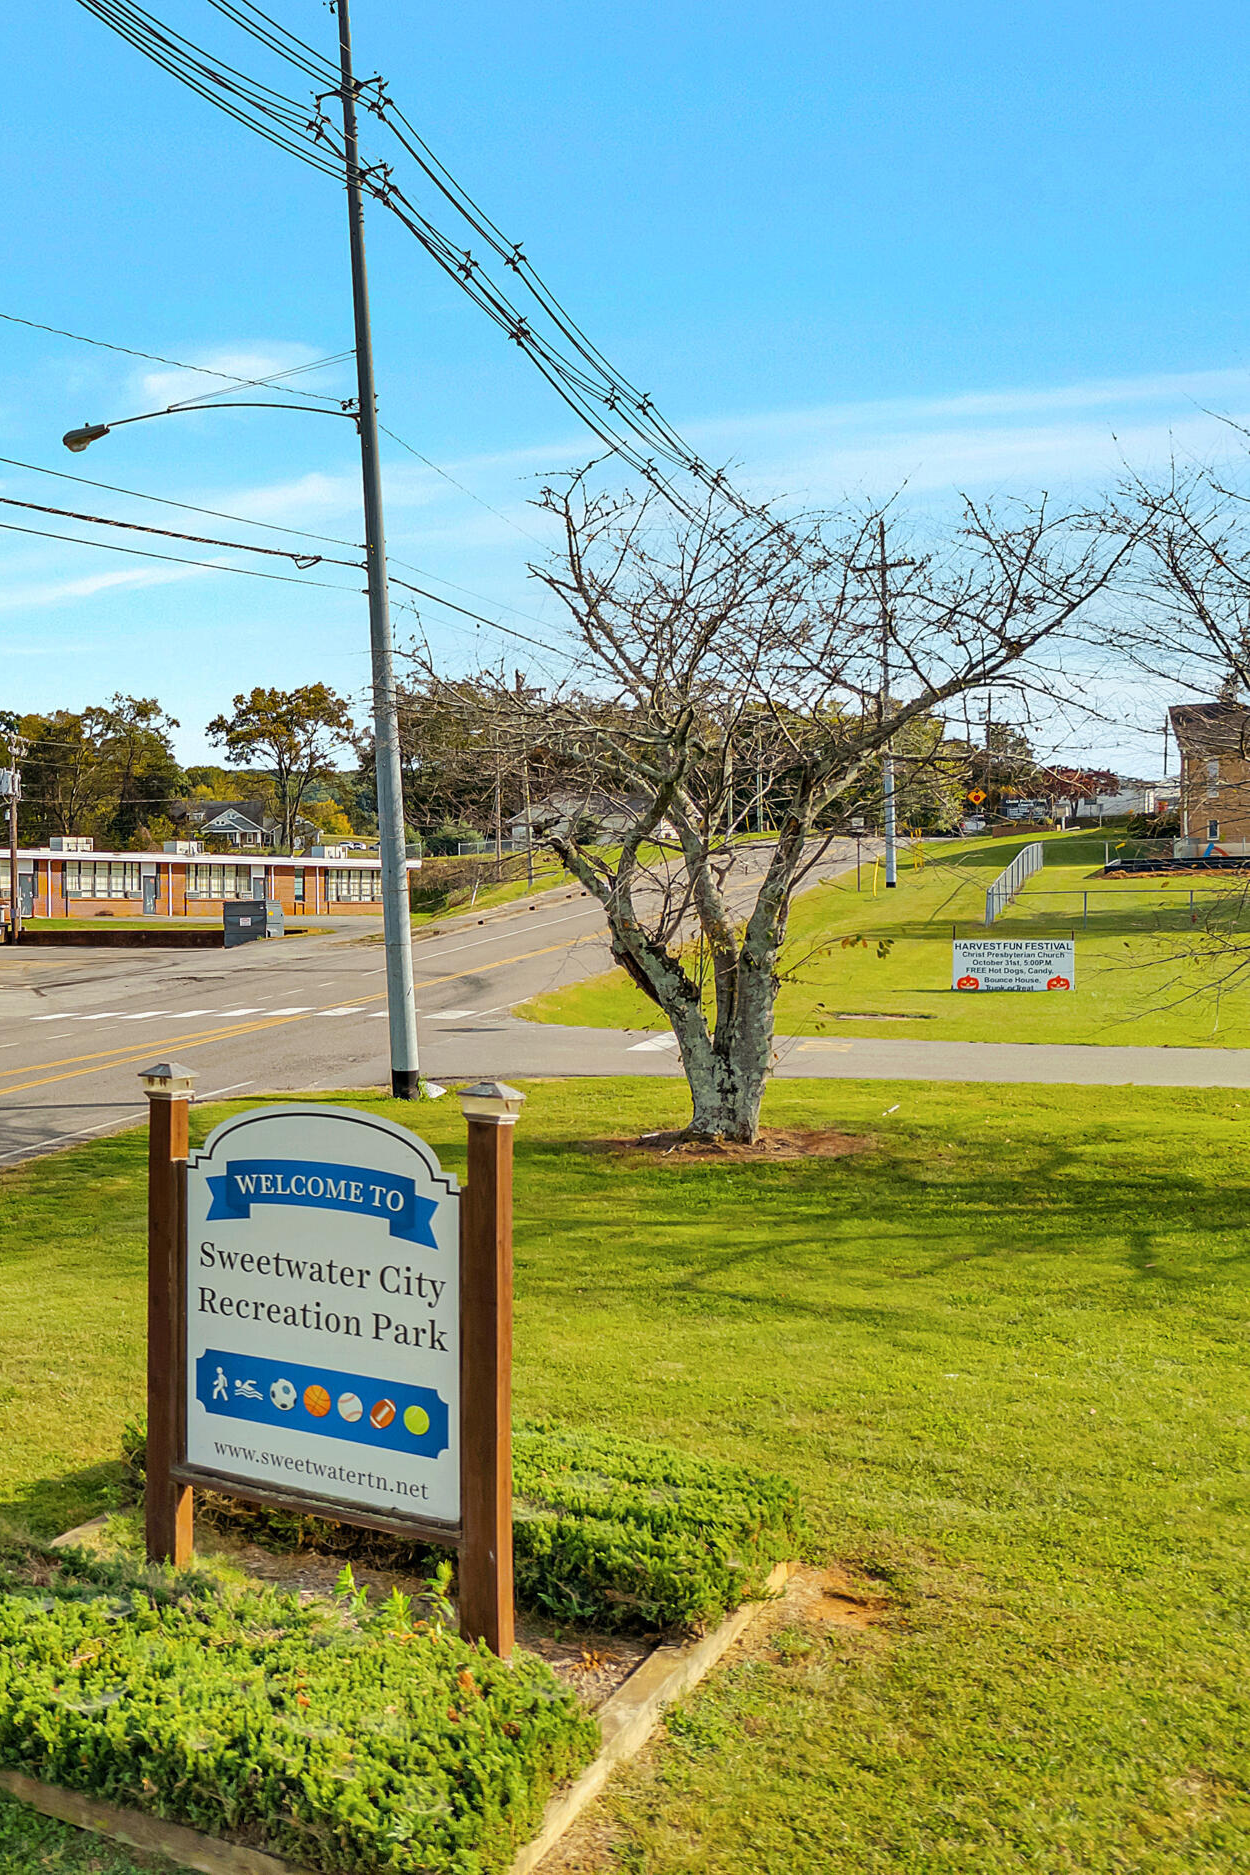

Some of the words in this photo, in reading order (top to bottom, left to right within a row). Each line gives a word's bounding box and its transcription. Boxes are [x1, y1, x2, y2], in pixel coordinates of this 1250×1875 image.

[955, 942, 1001, 950] HARVEST
[1003, 942, 1023, 950] FUN
[1025, 942, 1072, 950] FESTIVAL
[987, 951, 1036, 959] Presbyterian
[1004, 967, 1026, 975] Dogs,
[1005, 959, 1021, 967] 31st,
[234, 1174, 364, 1203] WELCOME
[369, 1185, 405, 1212] TO
[200, 1241, 371, 1289] Sweetwater
[379, 1265, 446, 1308] City
[197, 1286, 363, 1337] Recreation
[371, 1312, 449, 1352] Park
[214, 1439, 429, 1500] www.sweetwatertn.net
